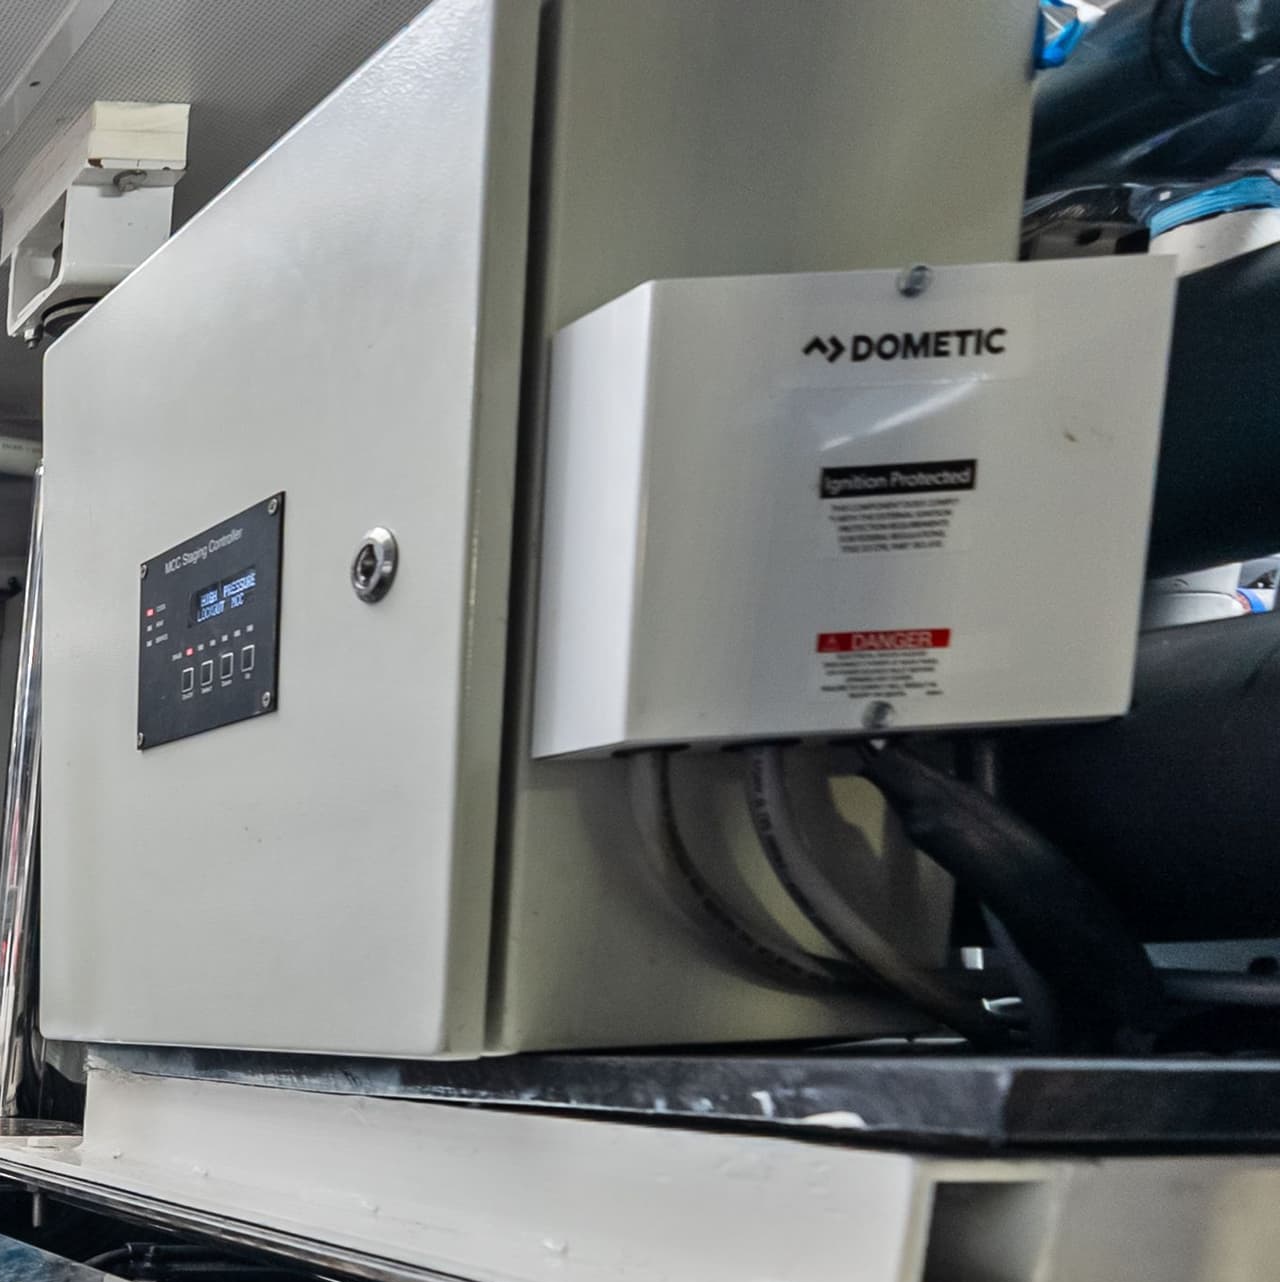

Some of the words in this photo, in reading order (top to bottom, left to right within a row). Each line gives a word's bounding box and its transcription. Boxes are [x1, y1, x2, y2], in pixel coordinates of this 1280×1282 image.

[850, 328, 1007, 362] DOMETIC
[824, 474, 888, 495] Ignition
[891, 466, 972, 487] Protected
[164, 556, 181, 574] MCC
[182, 546, 208, 565] Staging
[208, 528, 243, 553] Controller
[200, 590, 218, 608] HIGH
[223, 572, 256, 598] PRESSURE
[851, 631, 934, 650] DANGER
